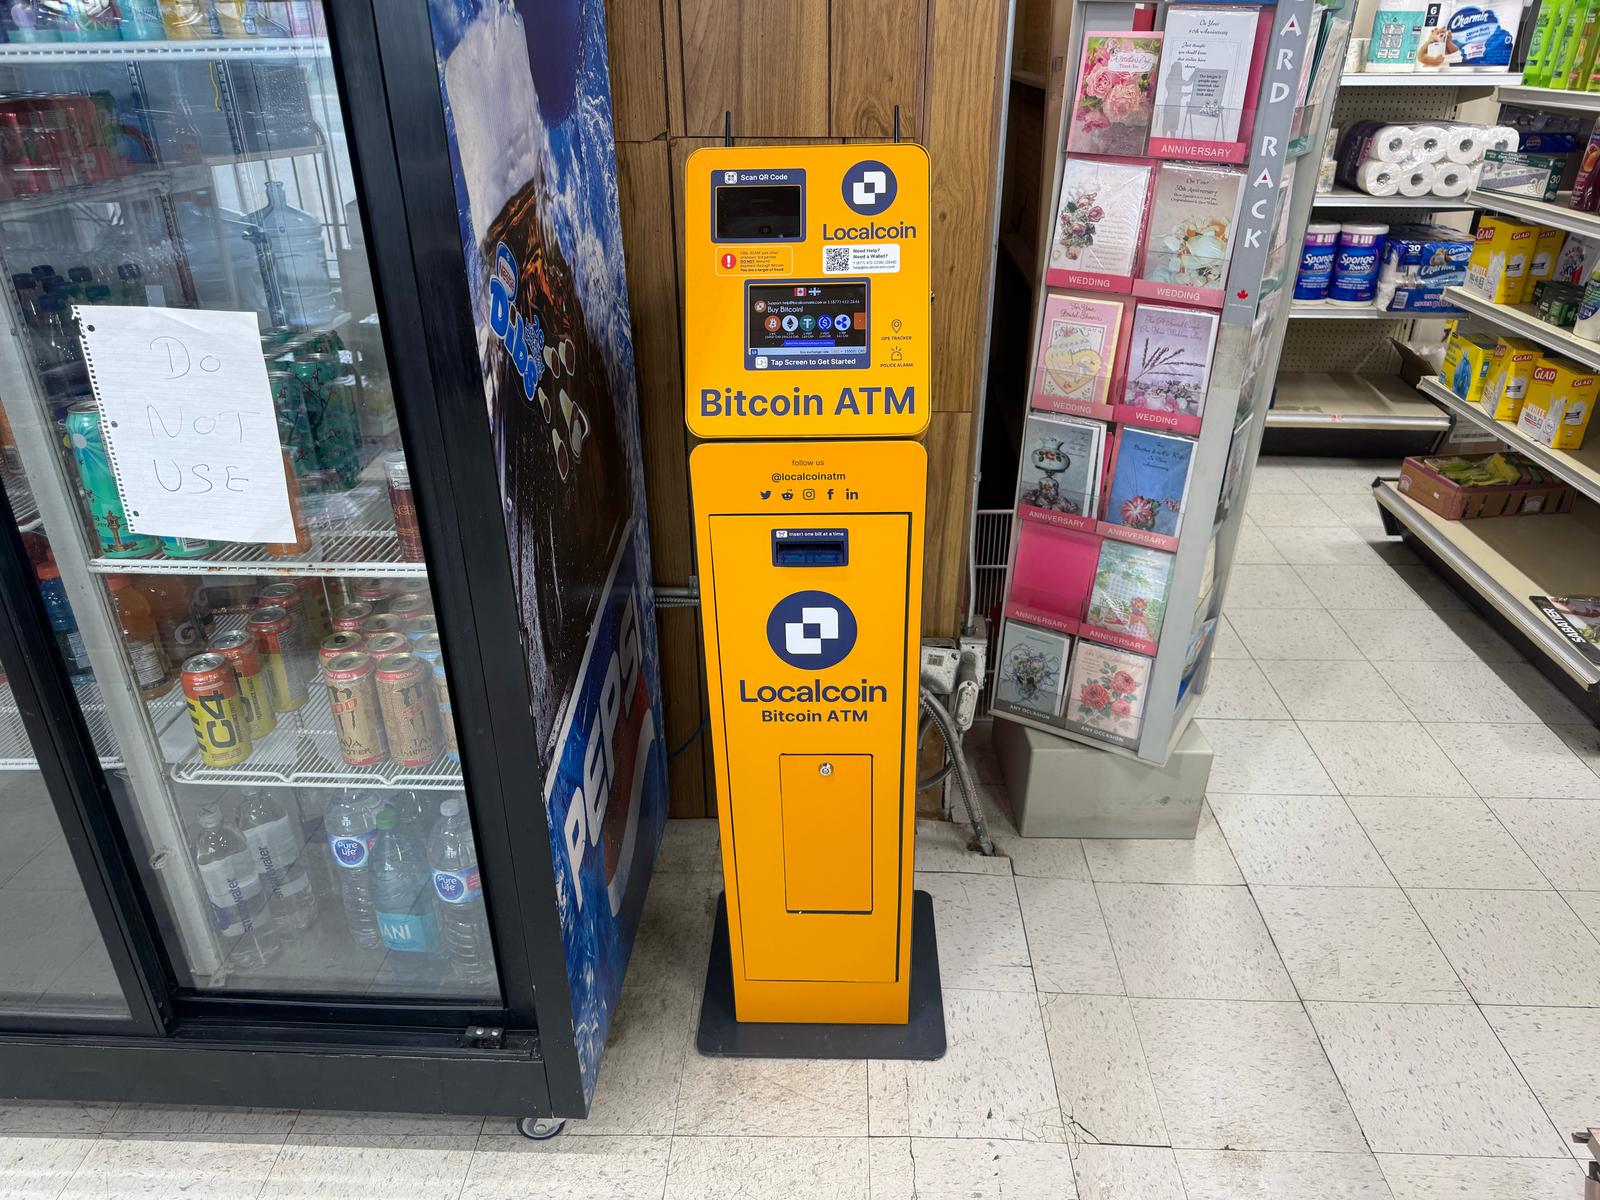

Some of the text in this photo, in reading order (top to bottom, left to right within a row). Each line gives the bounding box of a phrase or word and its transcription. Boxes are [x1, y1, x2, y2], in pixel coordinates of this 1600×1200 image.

[1452, 12, 1488, 29] Charmin
[1244, 0, 1302, 249] ARD RACK
[1161, 145, 1231, 158] ANNIVERSARY
[1528, 178, 1546, 194] 30
[823, 221, 916, 240] Localcoin
[1476, 229, 1494, 240] GLAD
[1340, 254, 1374, 266] Sponge
[1069, 275, 1110, 287] WEDDING
[1157, 288, 1200, 300] WEDDING
[489, 274, 538, 401] Dibs
[150, 336, 221, 380] Do
[1534, 368, 1556, 380] GLAD
[701, 386, 915, 416] Bitcoin ATM
[1053, 401, 1091, 414] WEDDING
[147, 405, 260, 443] NOT
[1136, 412, 1178, 425] WEDDING
[153, 459, 248, 494] USE
[772, 472, 846, 483] @localcoinatm
[1029, 511, 1084, 527] ANNIVERSARY
[1107, 528, 1166, 545] ANNIVERSARY
[1015, 610, 1067, 629] ANNIVERSARY
[1543, 608, 1586, 643] SABATIER
[1089, 630, 1146, 649] ANNIVERSARY
[740, 679, 887, 702] Localcoin
[199, 690, 236, 748] C4
[762, 710, 867, 722] Bitcoin ATM
[1022, 708, 1050, 719] OCCASION
[1094, 728, 1124, 742] OCCASION
[564, 581, 642, 912] PEPSI
[438, 875, 456, 885] Pure
